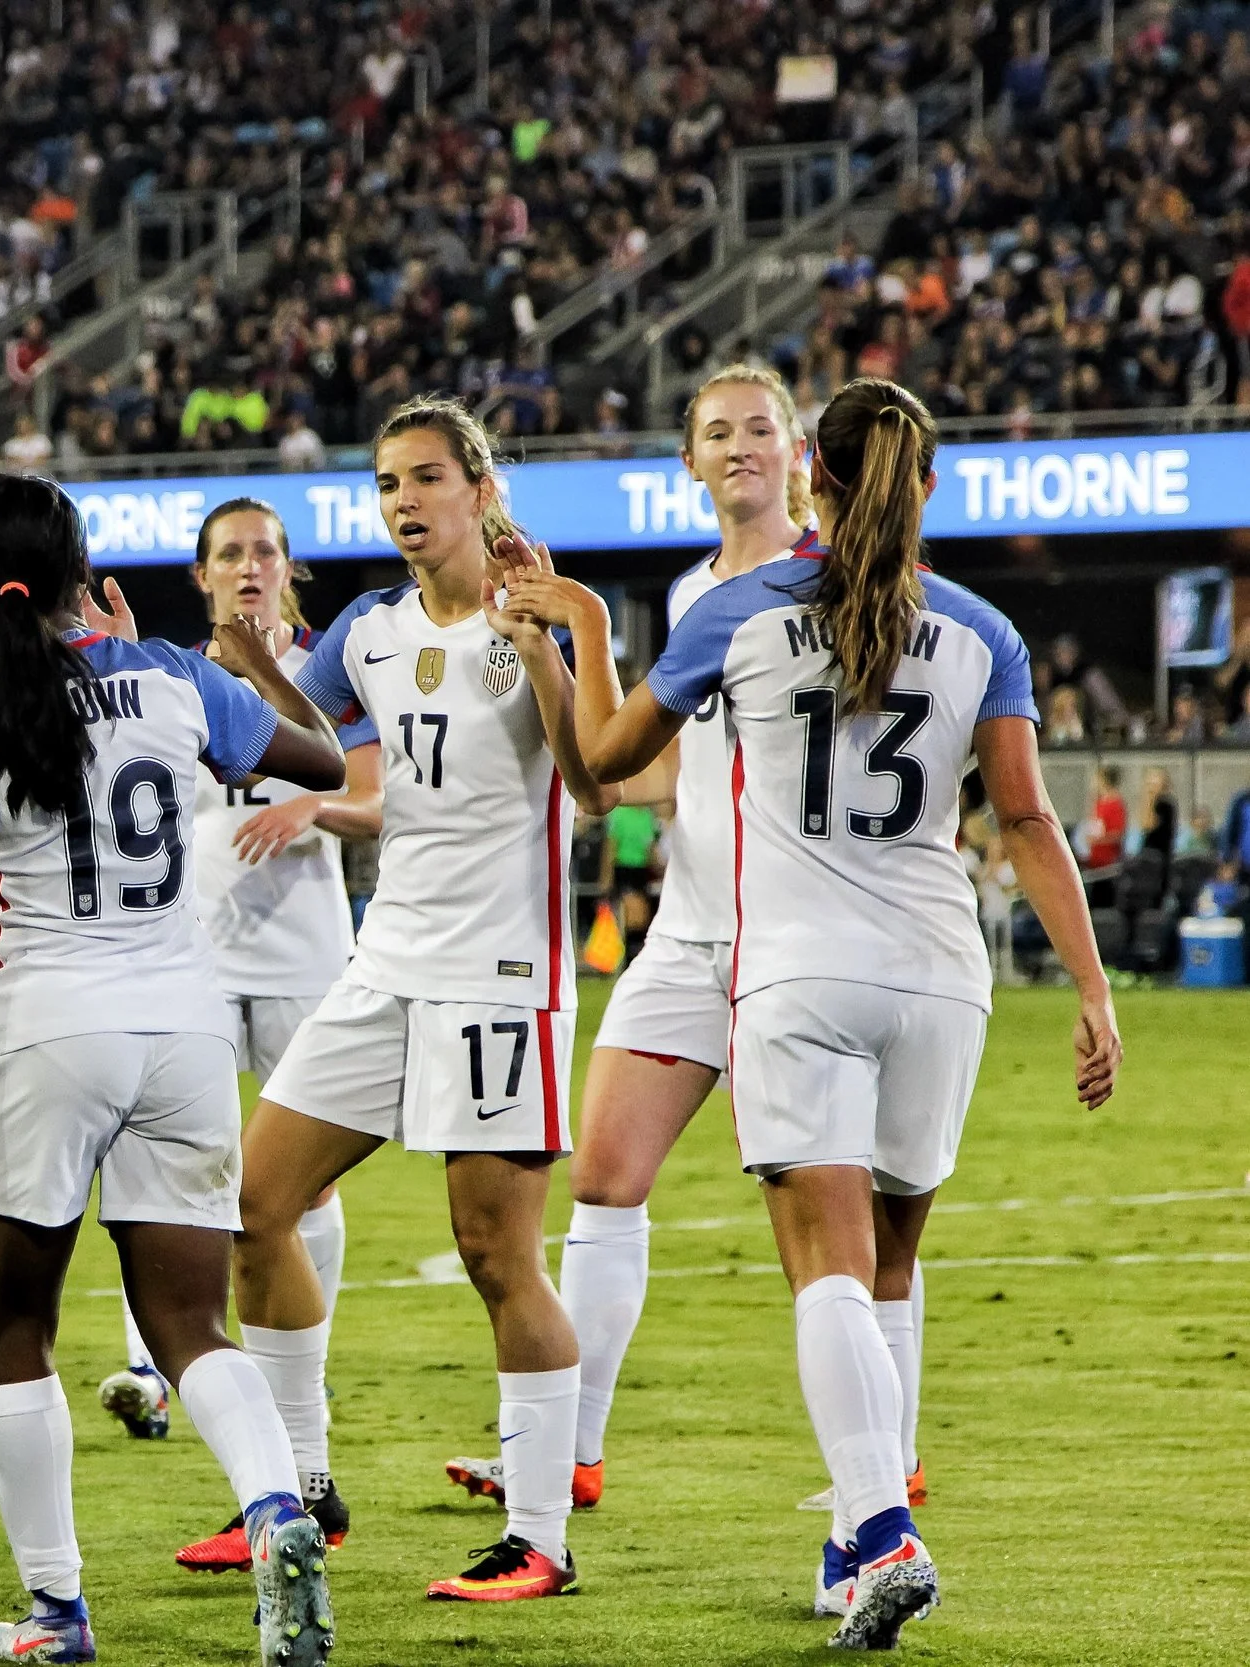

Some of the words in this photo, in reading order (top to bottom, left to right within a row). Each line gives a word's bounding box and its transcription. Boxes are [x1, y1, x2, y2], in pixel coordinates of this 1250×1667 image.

[955, 450, 1190, 520] THORNE
[489, 651, 516, 669] USA
[399, 713, 448, 788] 17
[791, 686, 933, 841] 13
[61, 756, 186, 921] 19
[462, 1021, 529, 1100] 17
